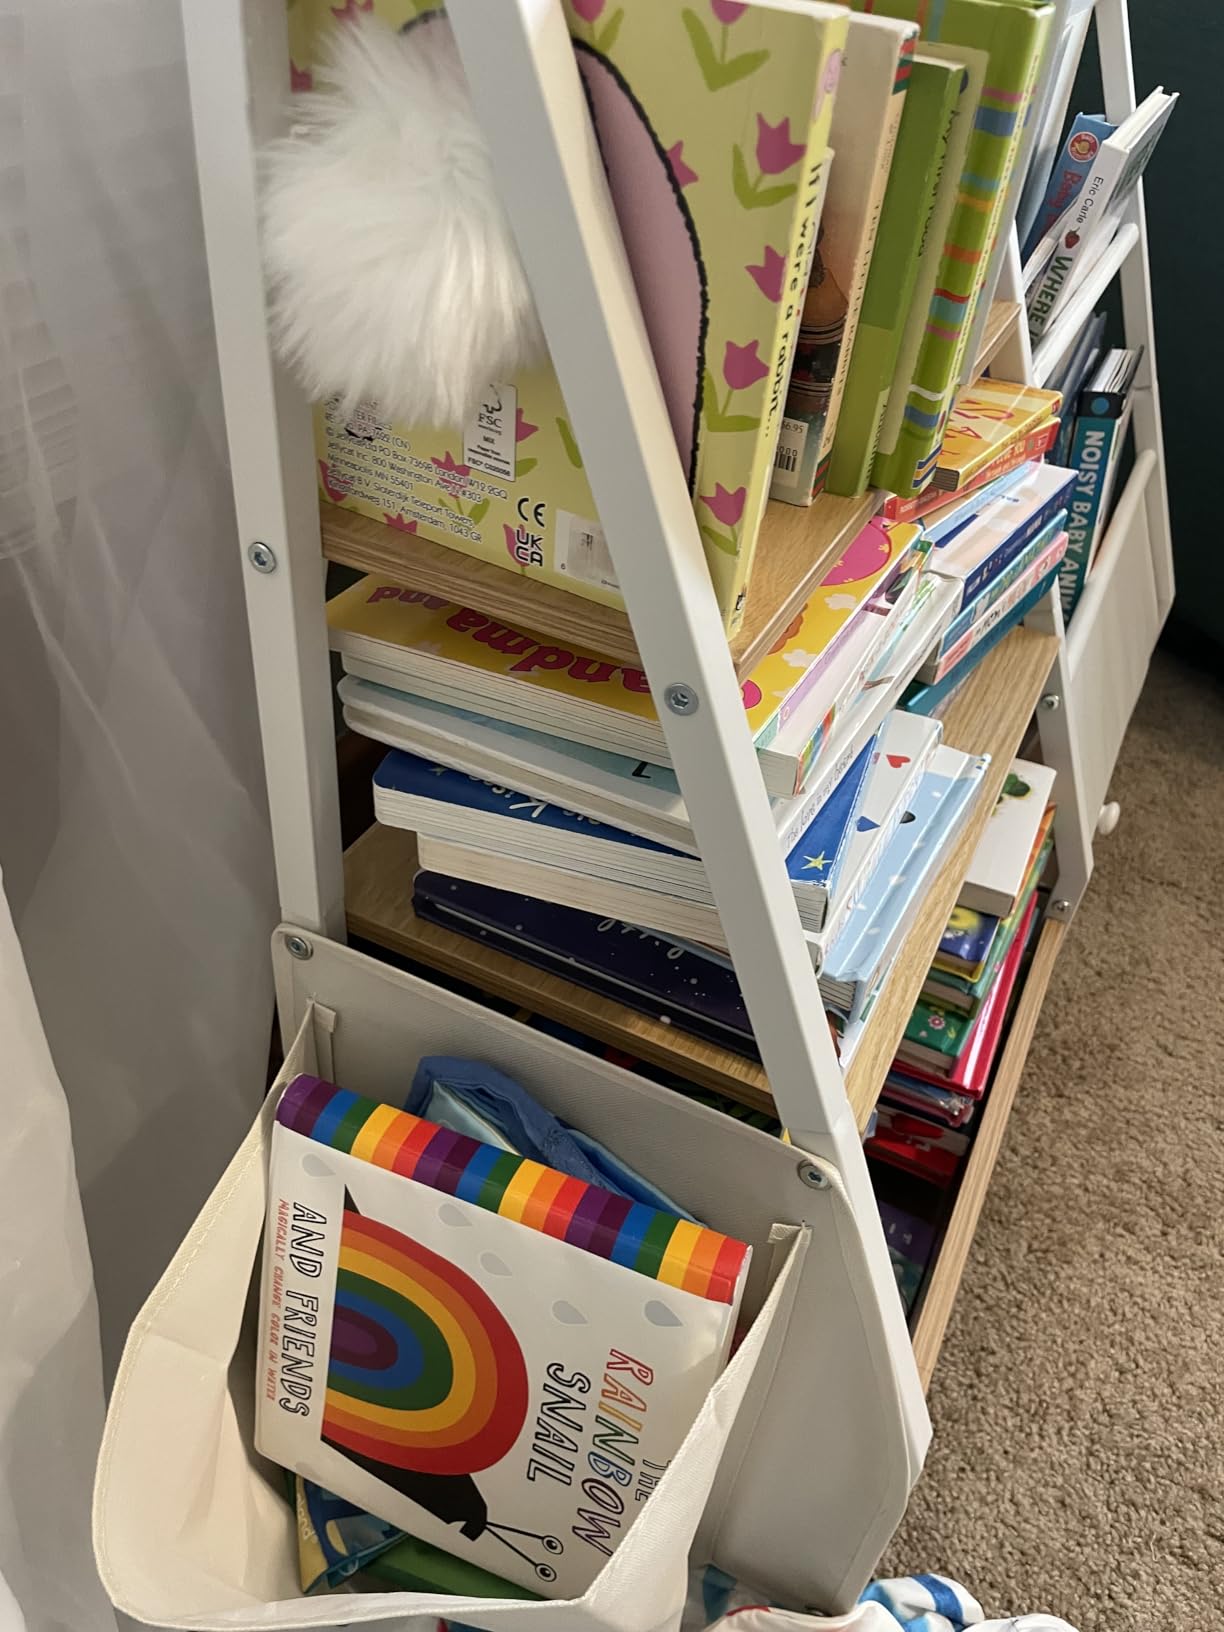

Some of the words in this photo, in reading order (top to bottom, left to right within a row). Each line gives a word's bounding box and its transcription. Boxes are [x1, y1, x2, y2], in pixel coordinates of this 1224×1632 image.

[1089, 176, 1104, 196] Eric
[1076, 198, 1094, 224] Carle
[790, 217, 810, 291] were
[1028, 256, 1073, 326] WHERE
[785, 304, 794, 320] a
[479, 412, 502, 429] FSC
[782, 420, 805, 434] 6.95
[328, 453, 373, 476] Minneapolis
[375, 470, 388, 481] MN
[372, 456, 388, 468] 800
[388, 462, 433, 486] Washington
[378, 445, 391, 457] PO
[392, 450, 406, 462] Box
[435, 465, 465, 483] London
[1075, 430, 1105, 497] NOISY
[517, 497, 546, 527] CE
[1067, 501, 1092, 555] BABY
[449, 523, 469, 538] 1043
[1059, 557, 1080, 621] ANIM
[274, 1199, 291, 1261] MAGICALLY
[289, 1201, 328, 1279] AND
[271, 1266, 285, 1310] CHANGE
[268, 1312, 281, 1346] COLOR
[267, 1350, 279, 1364] IN
[279, 1289, 319, 1417] FRIENDS
[265, 1368, 278, 1402] WATER
[526, 1362, 592, 1486] SNAIL
[571, 1348, 654, 1557] RAINBOW
